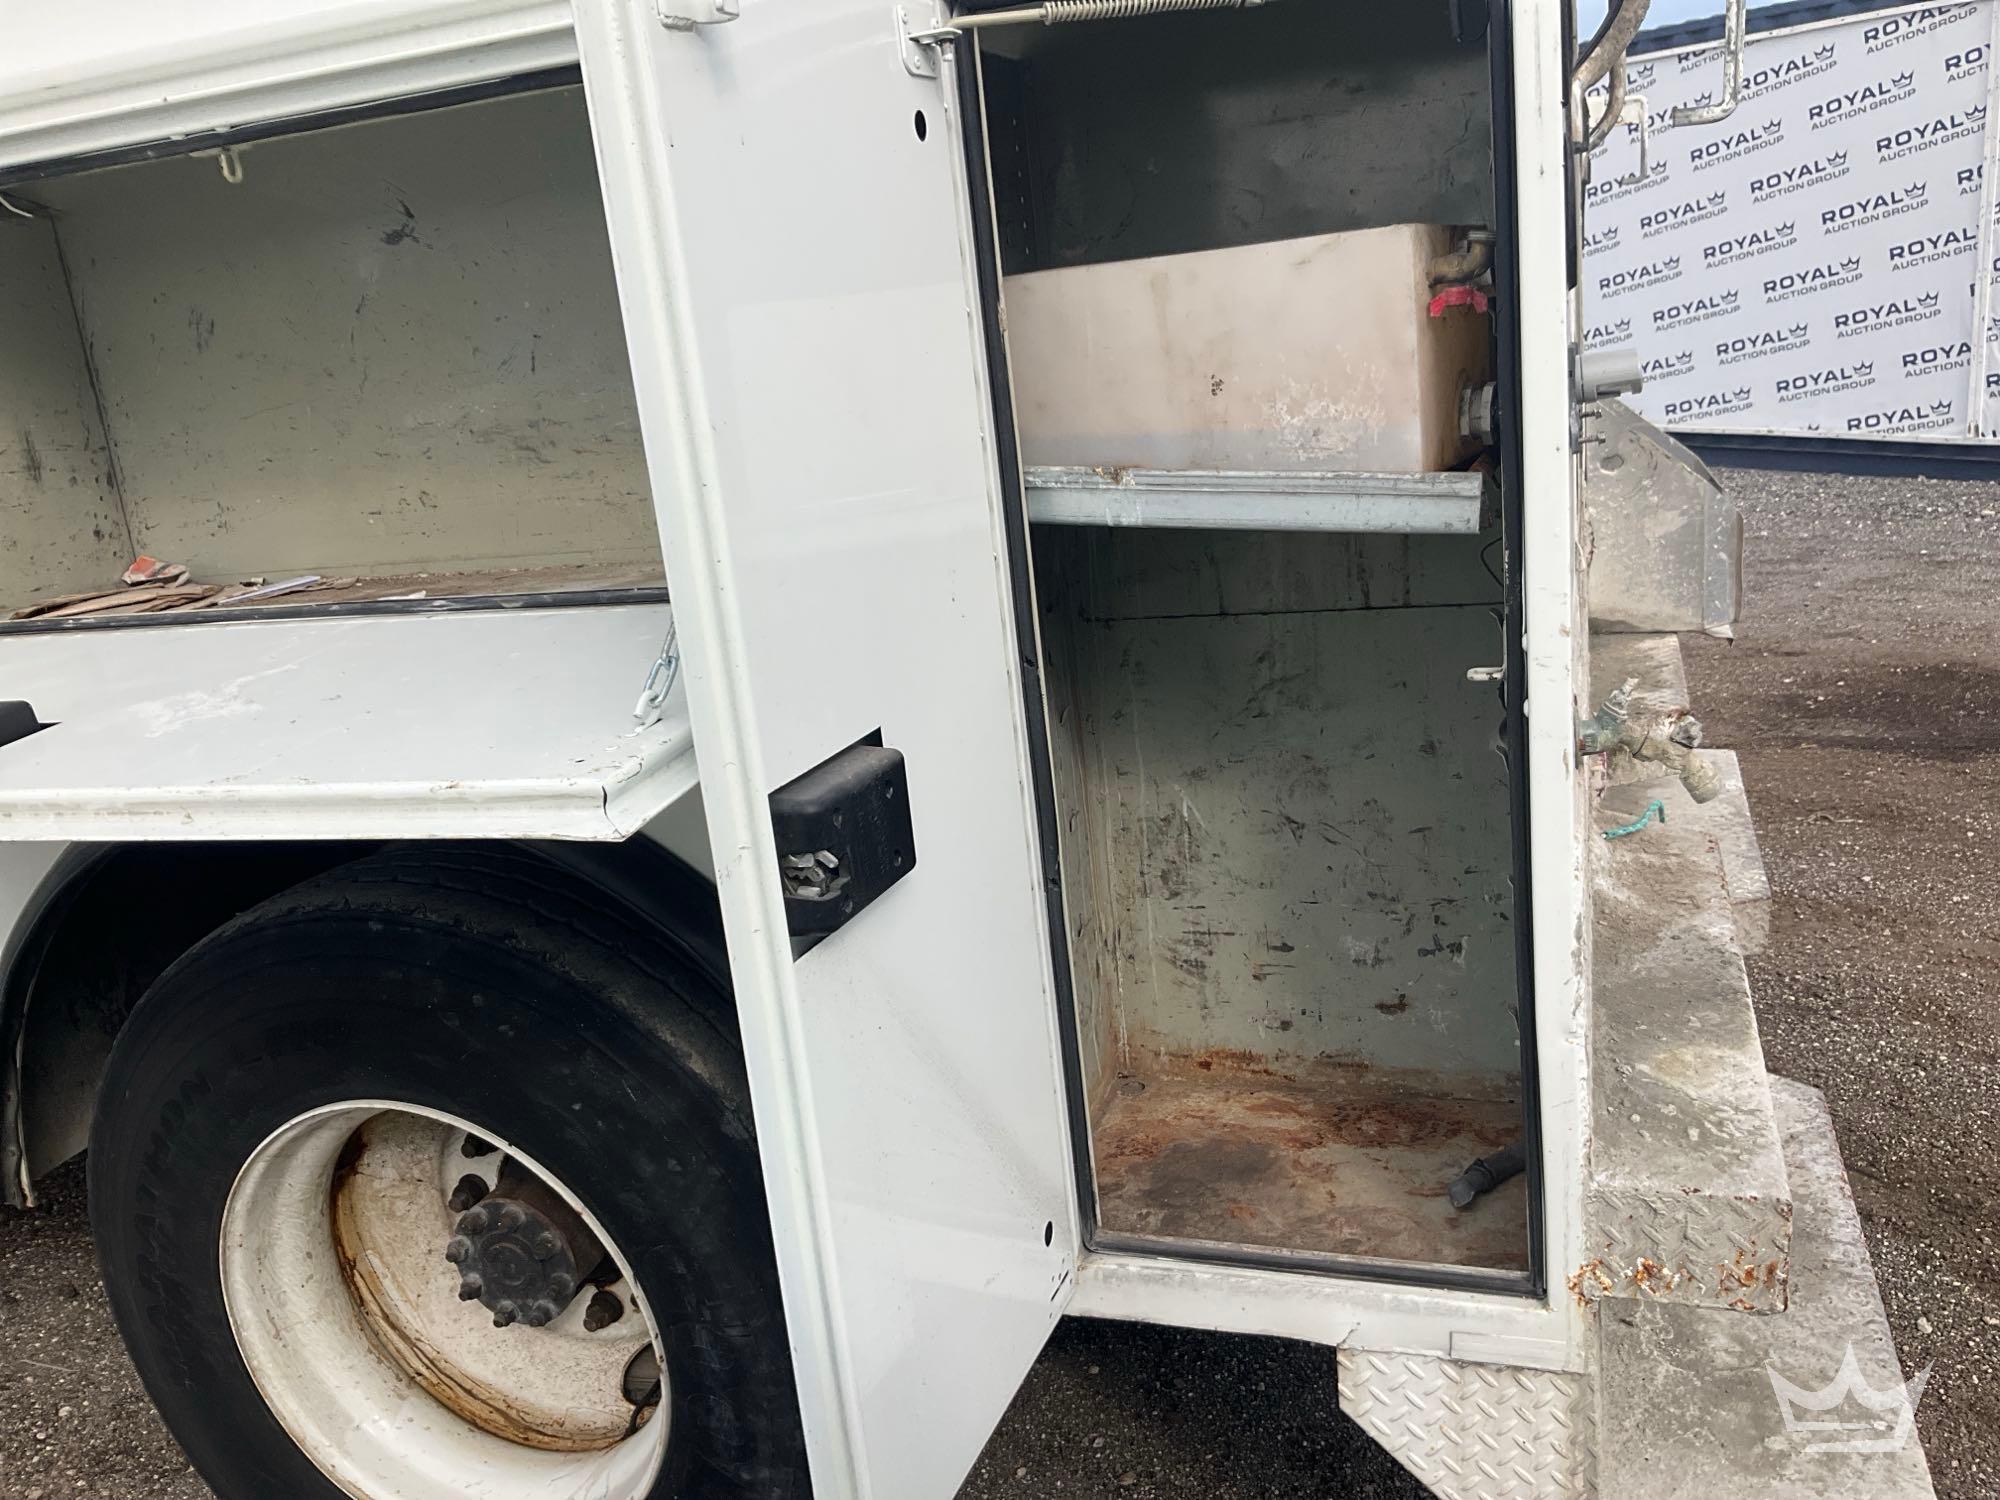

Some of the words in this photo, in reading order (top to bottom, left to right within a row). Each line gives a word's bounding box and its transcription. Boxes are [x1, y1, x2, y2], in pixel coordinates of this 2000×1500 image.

[1867, 26, 1926, 55] AUCTION
[1929, 6, 1977, 31] GROUP
[1740, 77, 1791, 102] AUCTION
[1793, 60, 1837, 82] GROUP
[1947, 62, 1989, 83] AUCTI
[1809, 82, 1891, 121] ROYAL
[1811, 106, 1867, 131] AUCTION
[1869, 87, 1916, 111] GROUP
[1690, 128, 1763, 162] ROYAL
[1876, 114, 1964, 153] ROYAL
[1693, 150, 1742, 172] AUCTION
[1743, 134, 1785, 154] GROUP
[1879, 138, 1938, 164] AUCTION
[1589, 188, 1632, 208] AUCTION
[1634, 175, 1669, 193] GROUP
[1750, 160, 1827, 194] ROYAL
[1752, 181, 1804, 204] AUCTION
[1807, 167, 1850, 187] GROUP
[1640, 199, 1708, 230] ROYAL
[1642, 219, 1688, 239] AUCTION
[1690, 206, 1728, 224] GROUP
[1822, 191, 1904, 225] ROYAL
[1824, 213, 1880, 235] AUCTION
[1883, 199, 1929, 218] GROUP
[1703, 230, 1776, 260] ROYAL
[1706, 249, 1755, 270] AUCTION
[1756, 237, 1797, 256] GROUP
[1889, 228, 1977, 261] ROYAL
[1891, 249, 1951, 272] AUCTION
[1599, 263, 1664, 291] ROYAL
[1602, 282, 1645, 299] AUCTION
[1647, 270, 1683, 287] GROUP
[1763, 264, 1840, 294] ROYAL
[1766, 281, 1817, 304] AUCTION
[1820, 272, 1863, 291] GROUP
[1653, 296, 1721, 324] ROYAL
[1655, 314, 1701, 332] AUCTION
[1703, 305, 1741, 320] GROUP
[1835, 300, 1917, 329] ROYAL
[1837, 320, 1893, 339] AUCTION
[1895, 309, 1941, 326] GROUP
[1583, 325, 1615, 341] YAL
[1599, 333, 1633, 348] GROUP
[1716, 329, 1789, 356] ROYAL
[1641, 357, 1676, 374] YAL
[1718, 348, 1768, 366] AUCTION
[1769, 339, 1810, 355] GROUP
[1902, 342, 1971, 368] ROYA
[1659, 365, 1695, 380] GROUP
[1776, 368, 1852, 393] ROYAL
[1904, 359, 1964, 378] AUCTION
[1665, 392, 1732, 416] ROYAL
[1778, 387, 1830, 403] AUCTION
[1833, 378, 1876, 393] GROUP
[1667, 410, 1713, 425] AUCTION
[1714, 403, 1753, 417] GROUP
[1847, 406, 1930, 431] ROYAL
[1908, 417, 1955, 432] GROUP
